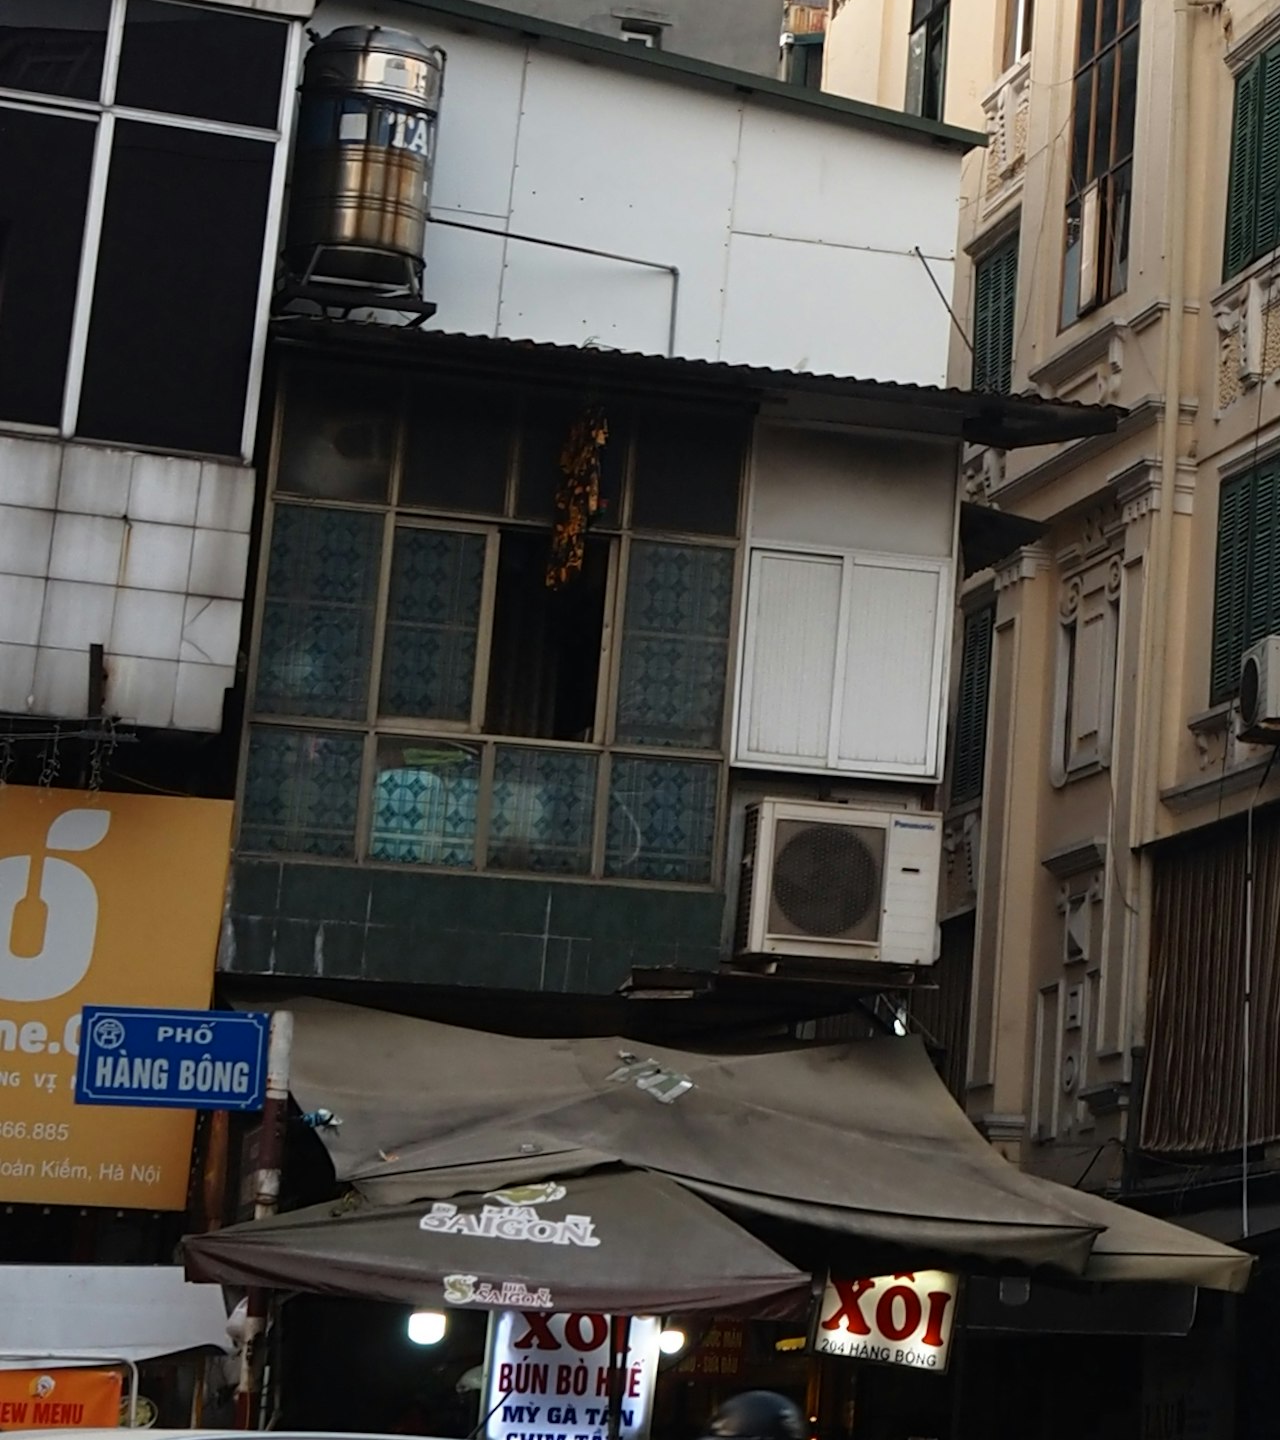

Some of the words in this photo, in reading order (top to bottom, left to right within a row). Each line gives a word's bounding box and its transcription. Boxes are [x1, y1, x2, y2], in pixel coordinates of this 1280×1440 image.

[157, 1021, 215, 1045] PHỐ
[94, 1049, 169, 1091] HÀNG
[177, 1052, 251, 1094] BÔNG
[498, 1356, 549, 1395] BÚN
[555, 1357, 590, 1397] BÒ
[0, 1402, 28, 1424] EW
[32, 1402, 84, 1425] MENU
